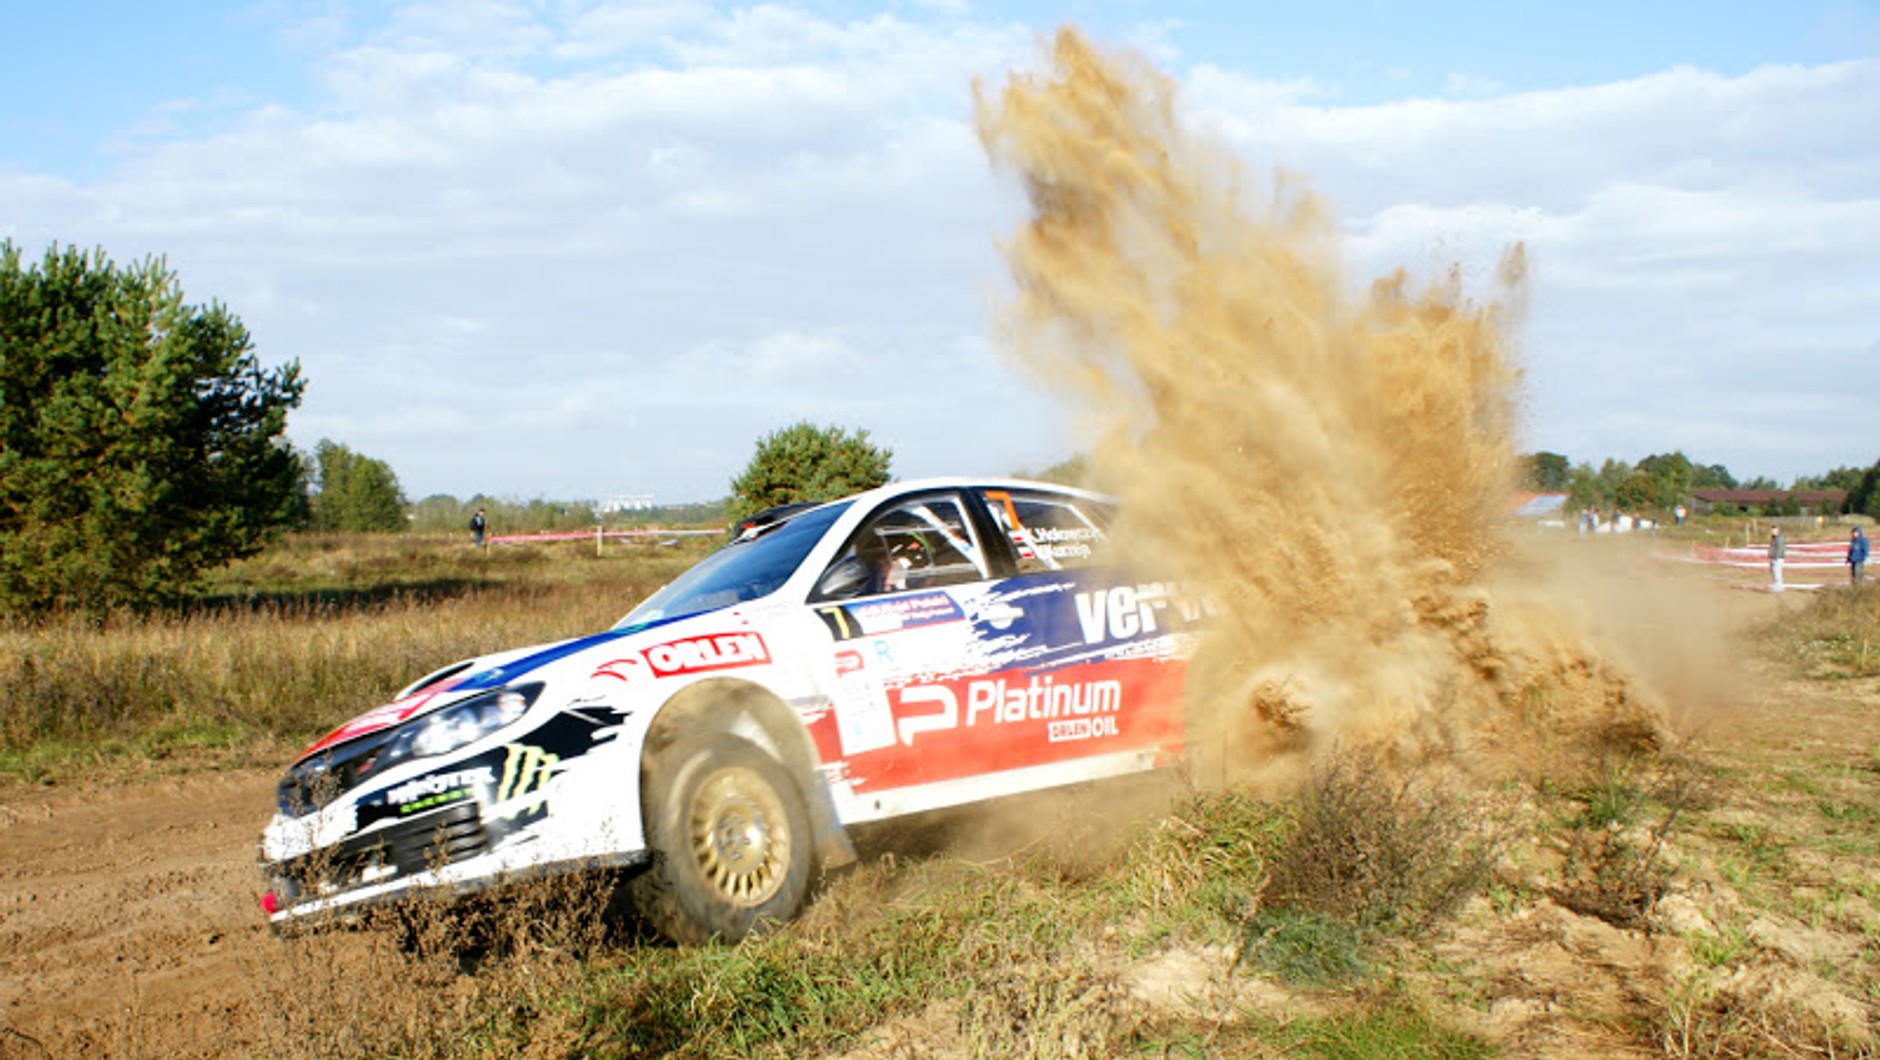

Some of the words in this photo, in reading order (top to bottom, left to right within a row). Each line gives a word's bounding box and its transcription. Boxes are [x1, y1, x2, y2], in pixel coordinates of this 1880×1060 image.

[984, 490, 1020, 531] 7
[820, 606, 850, 639] 7
[648, 632, 768, 672] ORLEN
[966, 676, 1121, 727] Platinum
[1051, 719, 1091, 740] ORLEN
[1092, 716, 1119, 738] OIL
